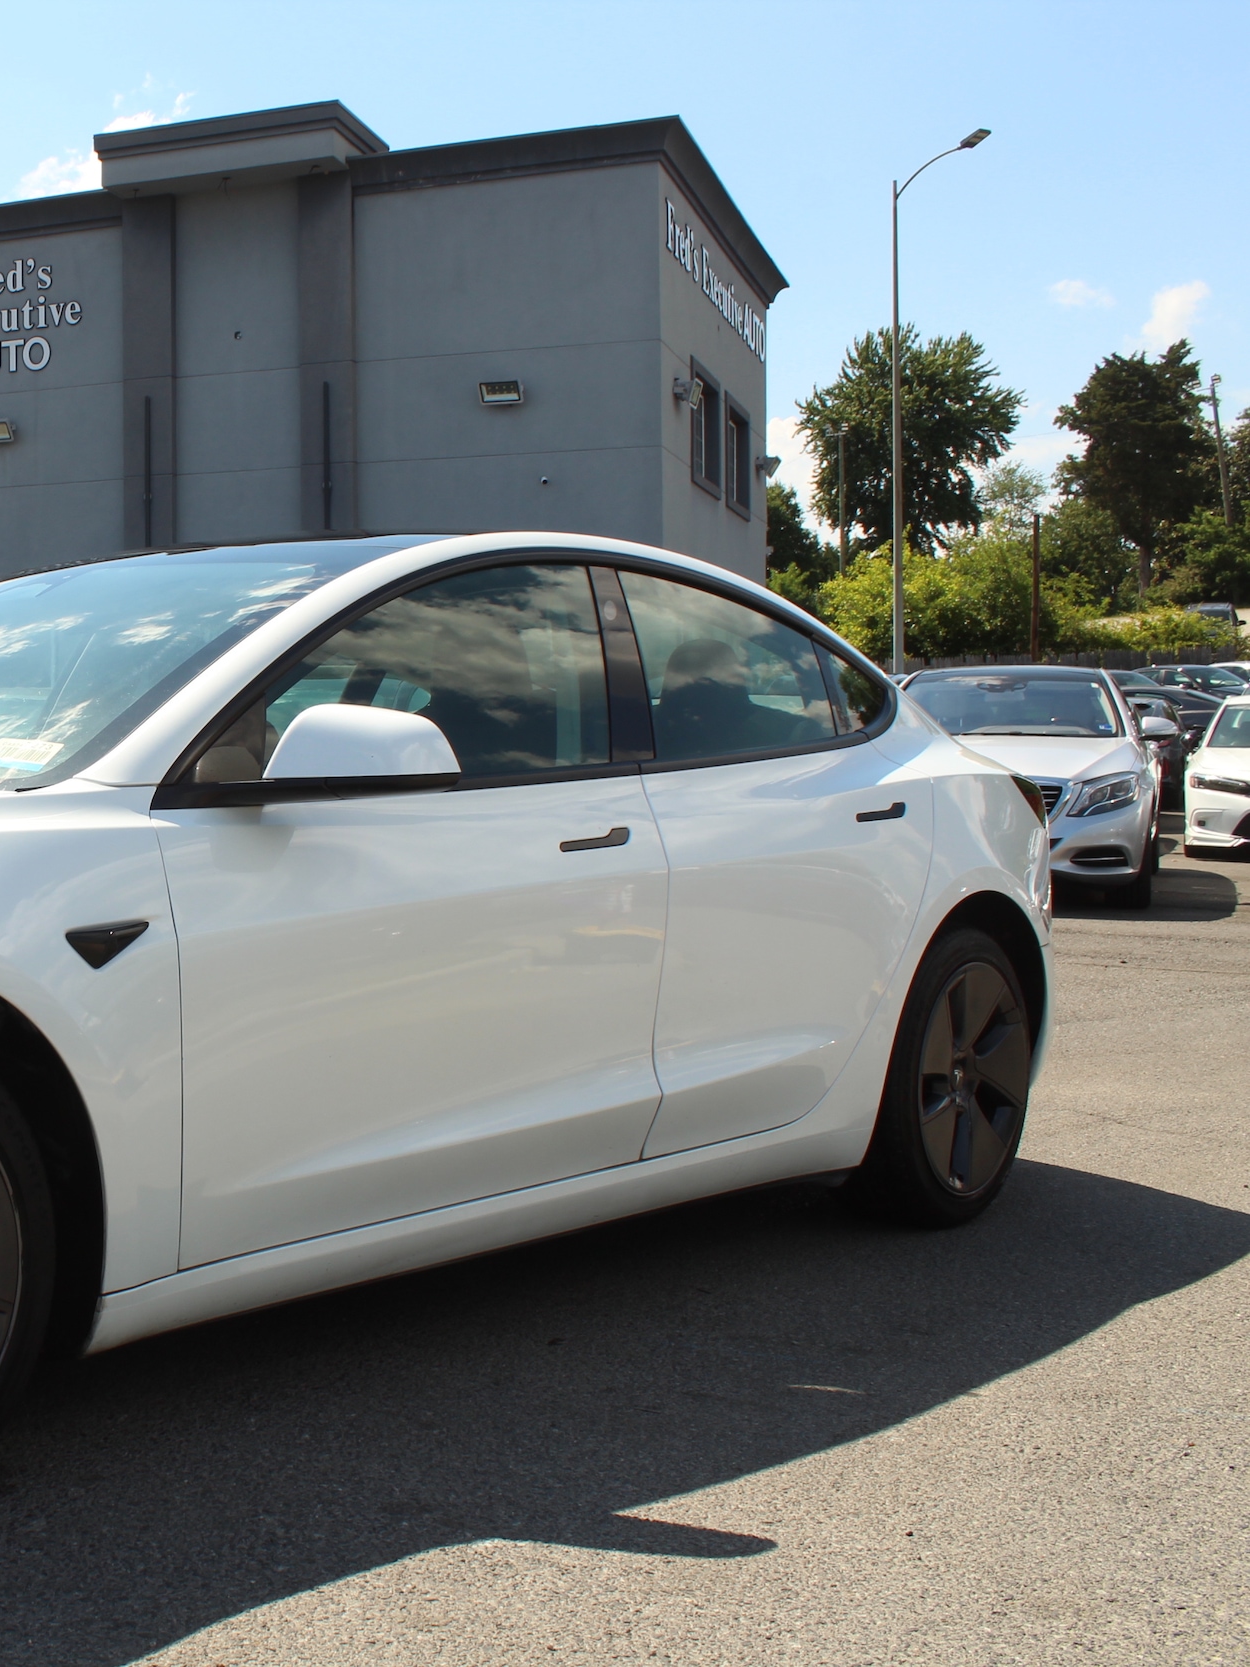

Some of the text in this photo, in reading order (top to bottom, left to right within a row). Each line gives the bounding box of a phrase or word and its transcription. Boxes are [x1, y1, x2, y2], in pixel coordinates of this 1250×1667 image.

[664, 197, 767, 363] Fred's Executive AUTO
